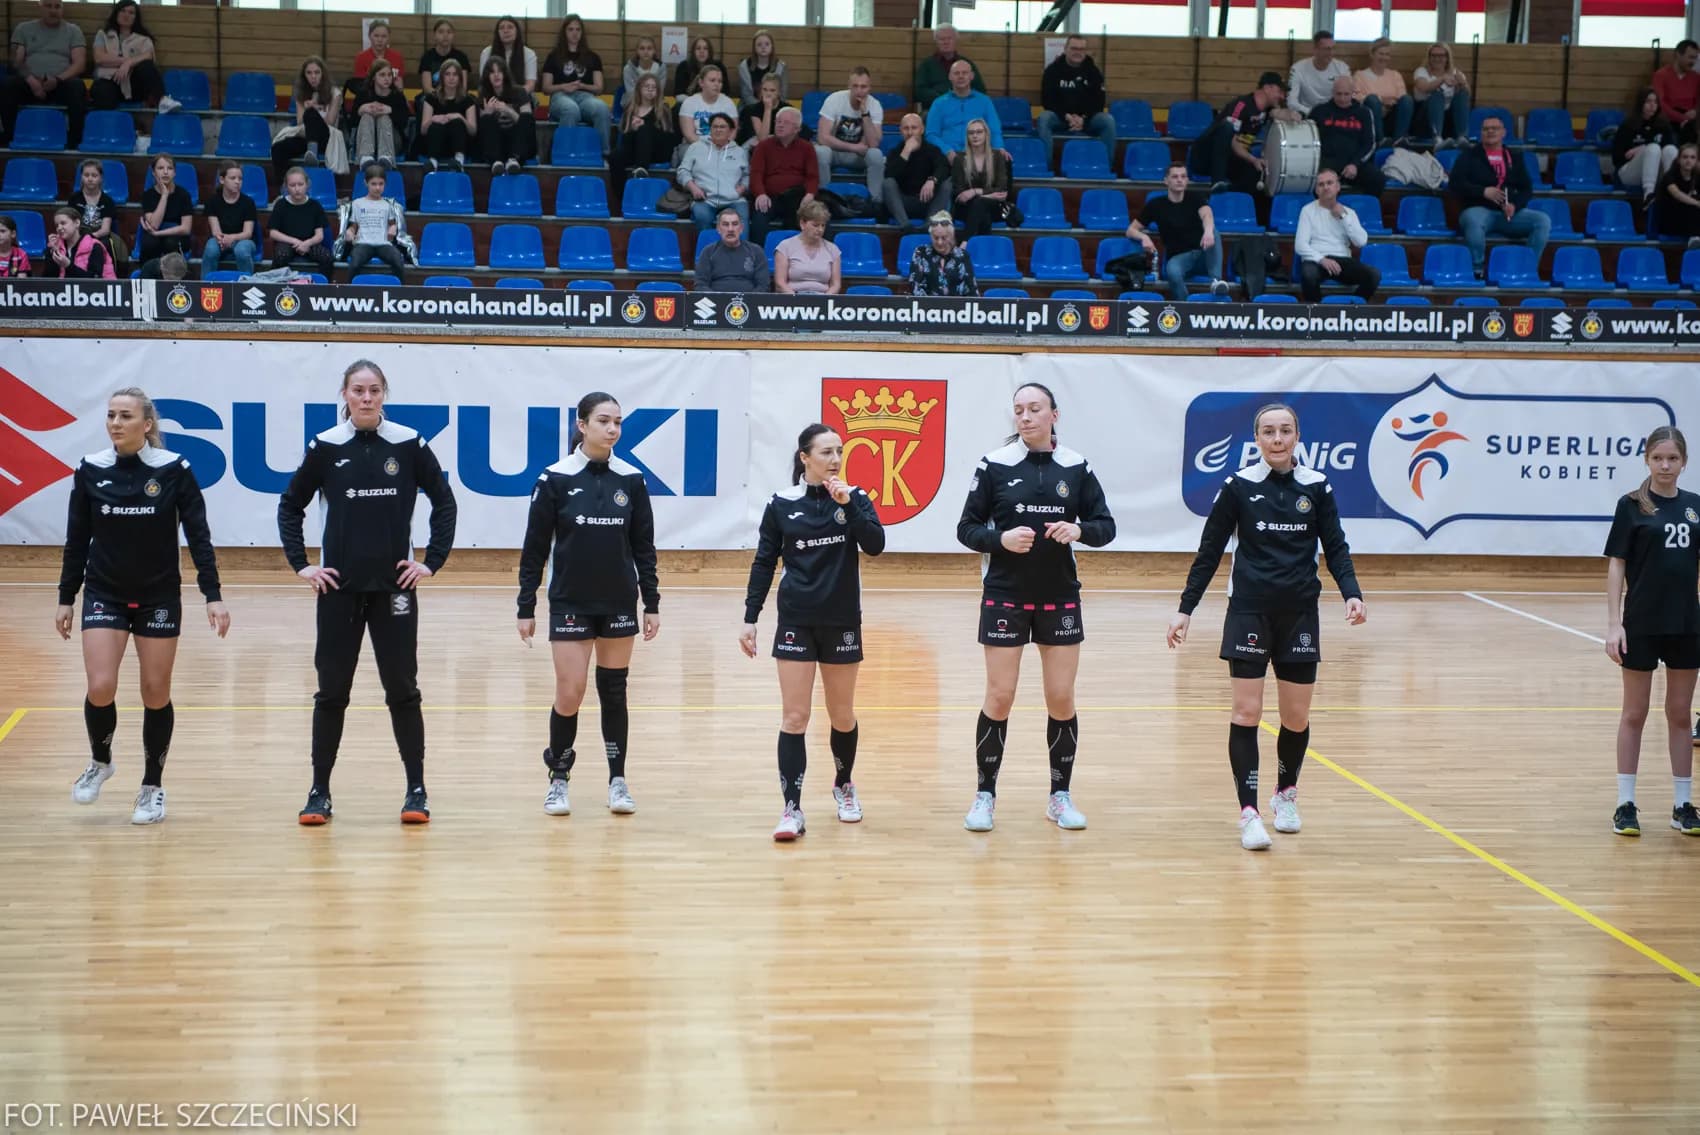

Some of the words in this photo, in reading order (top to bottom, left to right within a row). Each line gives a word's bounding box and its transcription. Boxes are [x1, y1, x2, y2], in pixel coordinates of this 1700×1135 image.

[309, 291, 612, 323] www.koronahandball.pl
[757, 299, 1049, 332] www.koronahandball.pl
[1189, 308, 1474, 340] www.koronahandball.pl
[1239, 441, 1358, 470] PNiG
[839, 437, 921, 507] CK
[1520, 464, 1617, 480] KOBIET
[357, 487, 398, 497] SUZUKI
[112, 506, 155, 515] SUZUKI
[1027, 504, 1065, 514] SUZUKI
[586, 516, 625, 526] SUZUKI
[1268, 522, 1308, 532] SUZUKI
[807, 534, 846, 547] SUZUKI
[1664, 523, 1690, 548] 28
